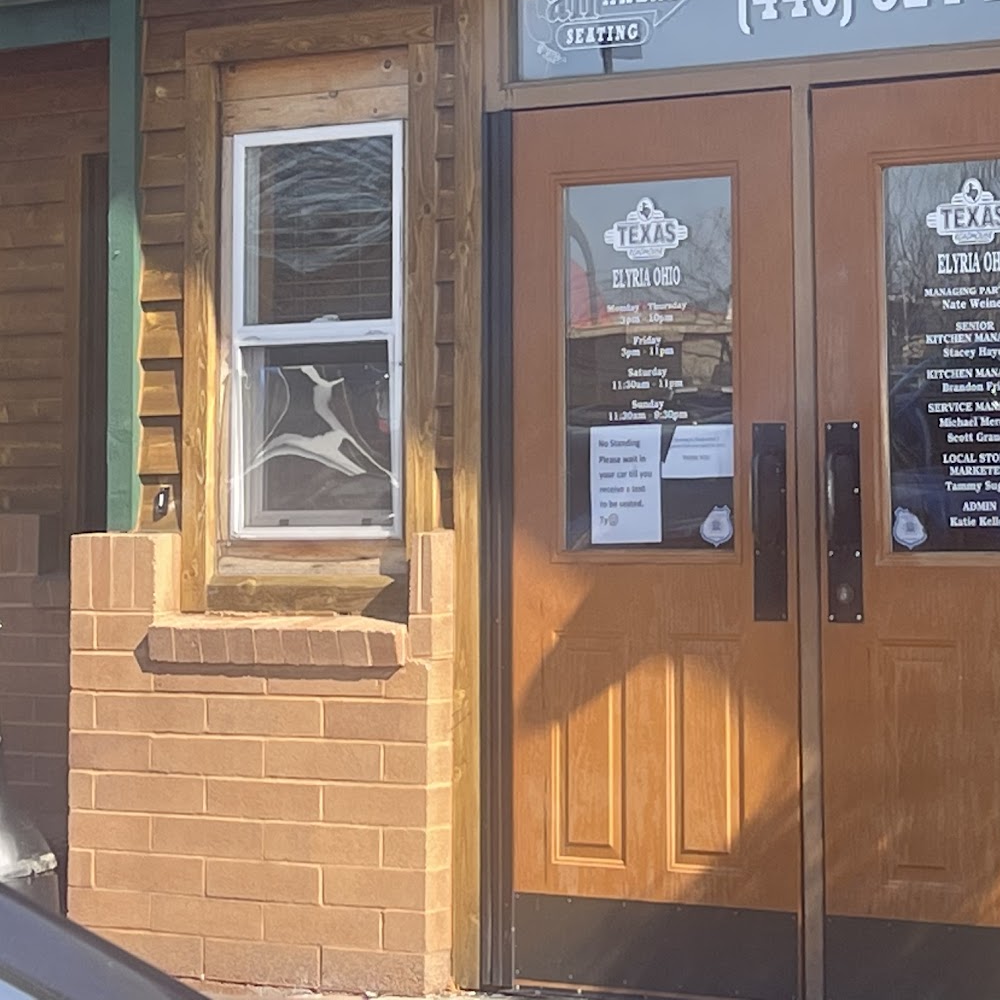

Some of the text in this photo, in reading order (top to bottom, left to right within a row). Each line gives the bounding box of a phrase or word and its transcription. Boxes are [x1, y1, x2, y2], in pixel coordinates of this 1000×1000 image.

[565, 22, 639, 46] SEATING
[616, 222, 677, 247] TEXAS
[937, 252, 981, 275] ELYRIA
[612, 265, 681, 289] ELYRIA OHIO
[924, 286, 977, 297] MANAGING
[942, 298, 967, 310] Nate
[955, 321, 996, 332] SENIOR
[925, 333, 972, 345] KITCHEN
[943, 347, 976, 360] Stacey
[627, 366, 668, 379] Saturday
[926, 368, 973, 380] KITCHEN
[942, 382, 984, 393] Brandon
[631, 399, 665, 411] Sunday
[927, 401, 973, 413] SERVICE
[939, 416, 978, 428] Michael
[947, 432, 974, 443] Scott
[942, 453, 977, 464] LOCAL
[944, 480, 982, 494] Tammy
[962, 501, 997, 512] ADMIN
[949, 516, 976, 527] Katie
